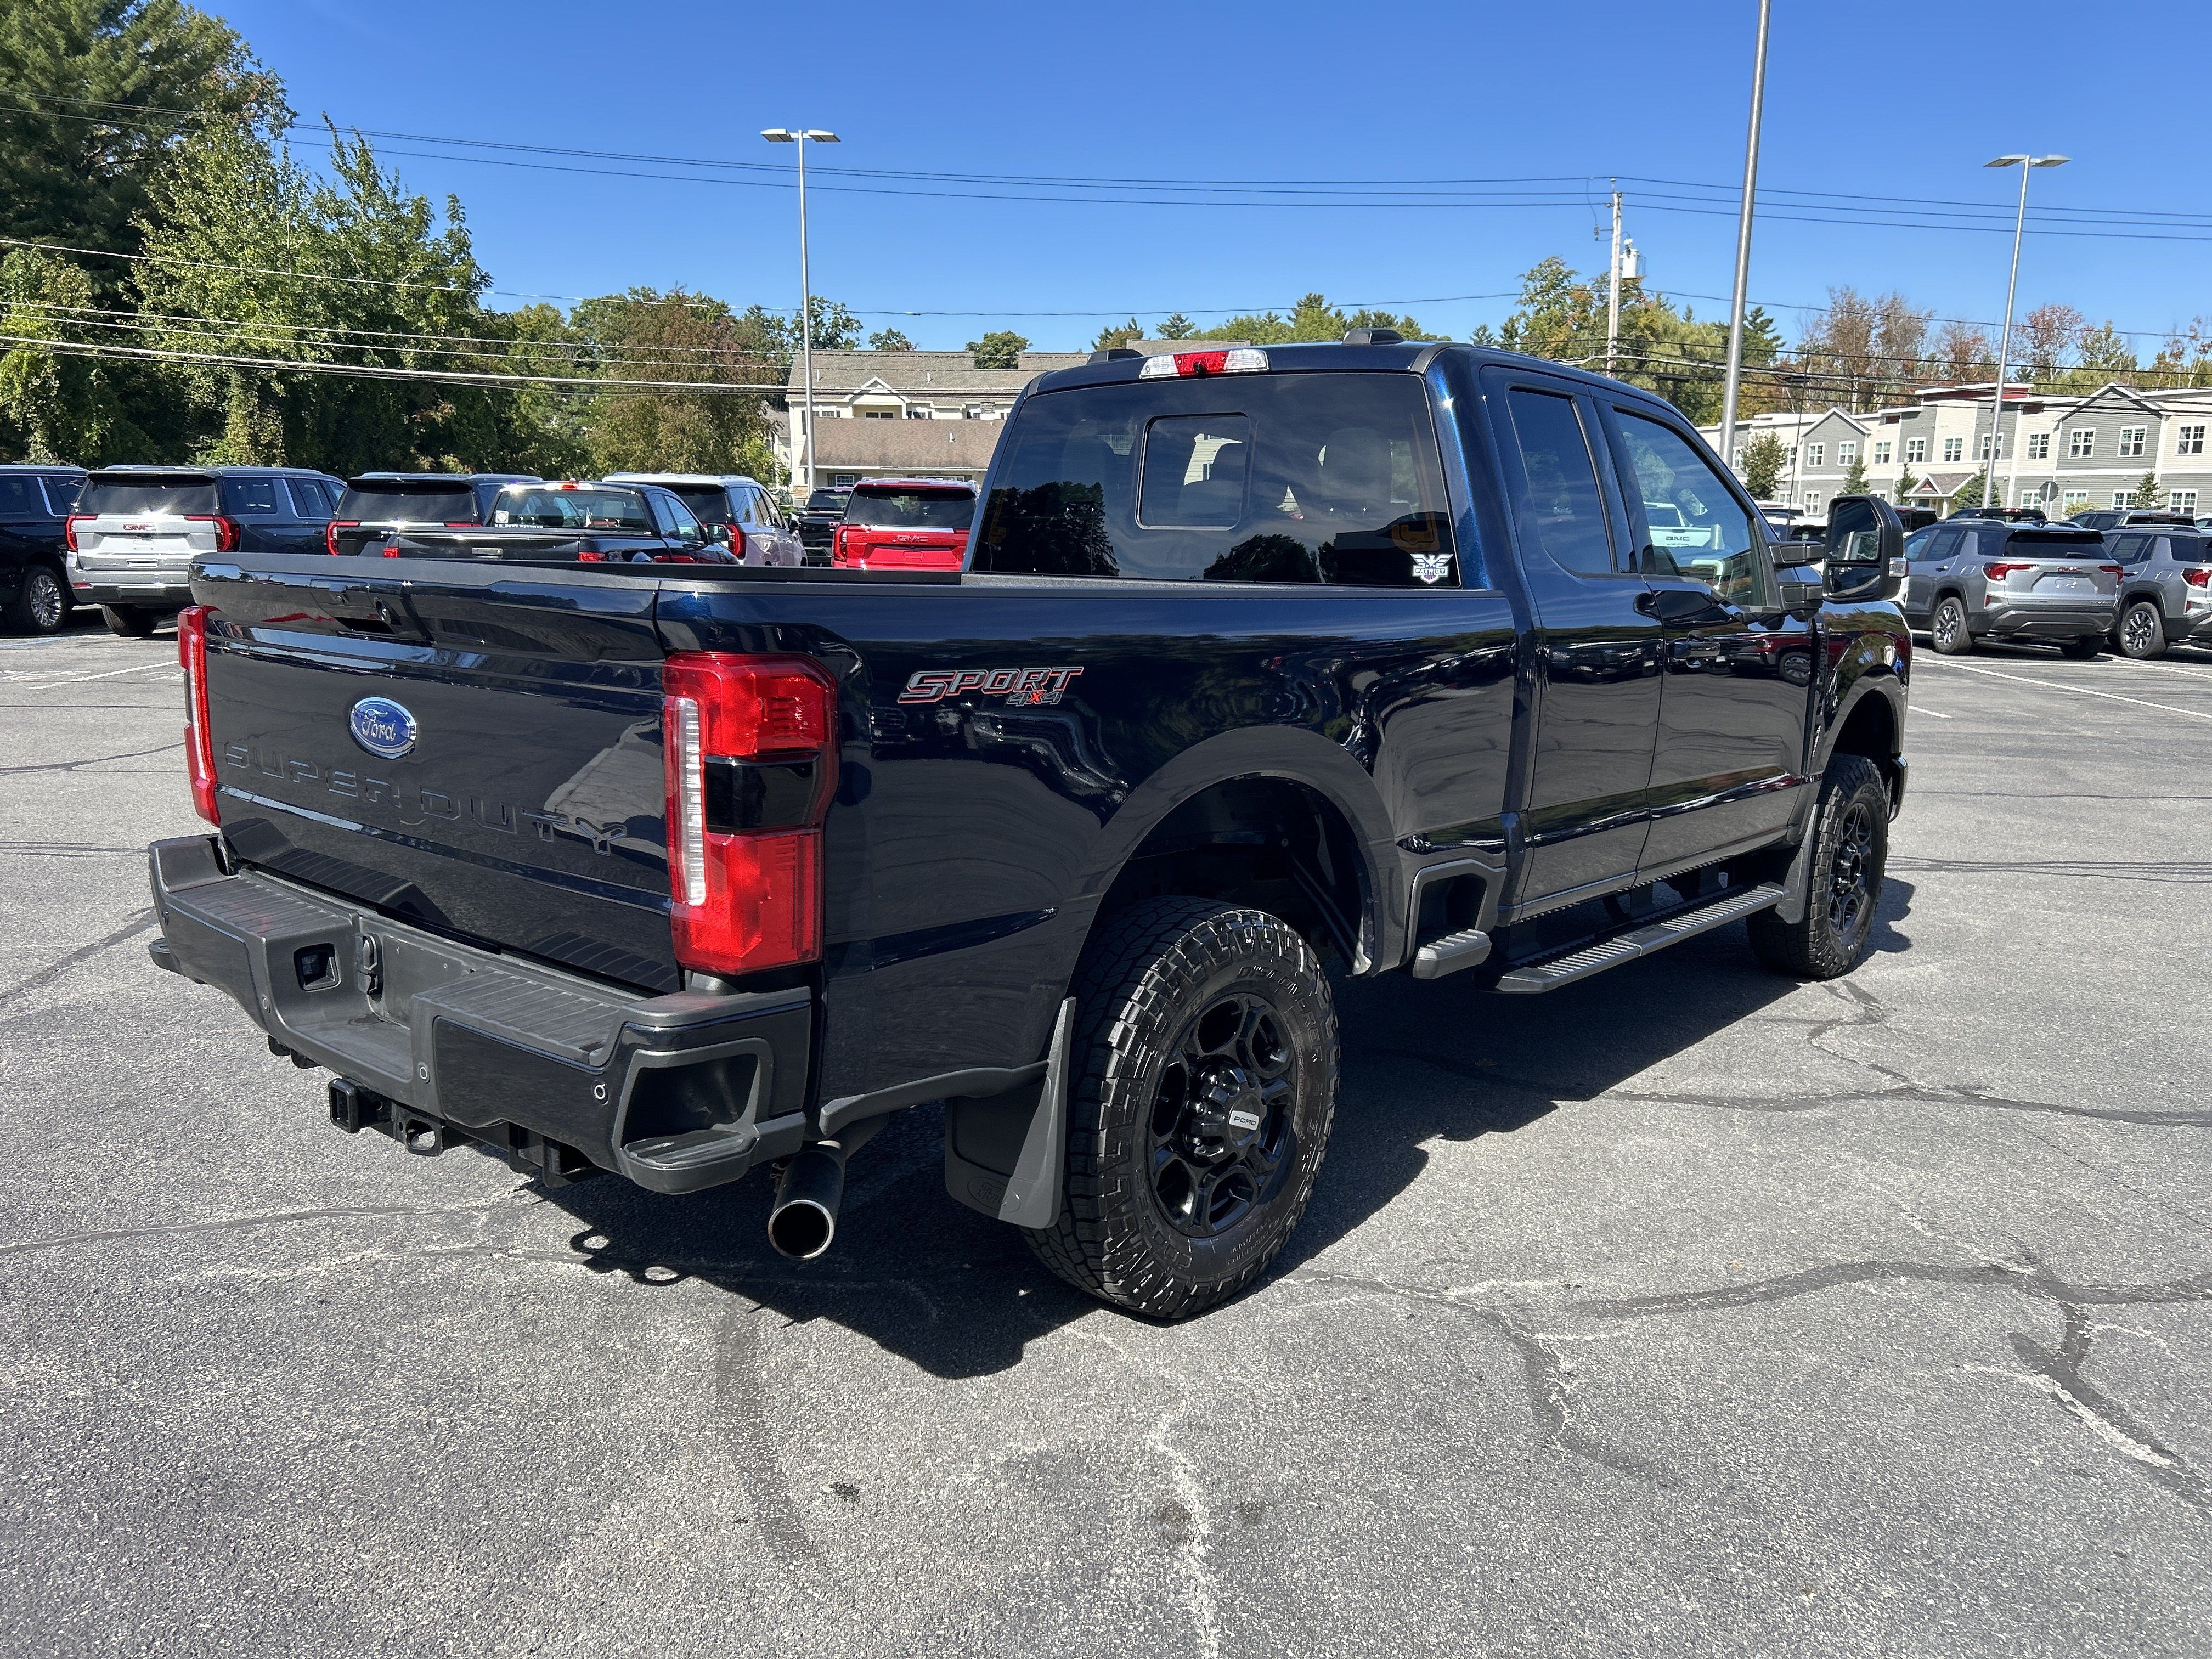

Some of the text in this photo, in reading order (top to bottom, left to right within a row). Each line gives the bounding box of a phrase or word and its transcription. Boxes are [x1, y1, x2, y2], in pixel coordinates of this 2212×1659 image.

[897, 667, 1084, 704] SPORT
[362, 708, 397, 741] Ford
[225, 743, 628, 856] SUPER DUTY
[1234, 1116, 1257, 1126] FORD
